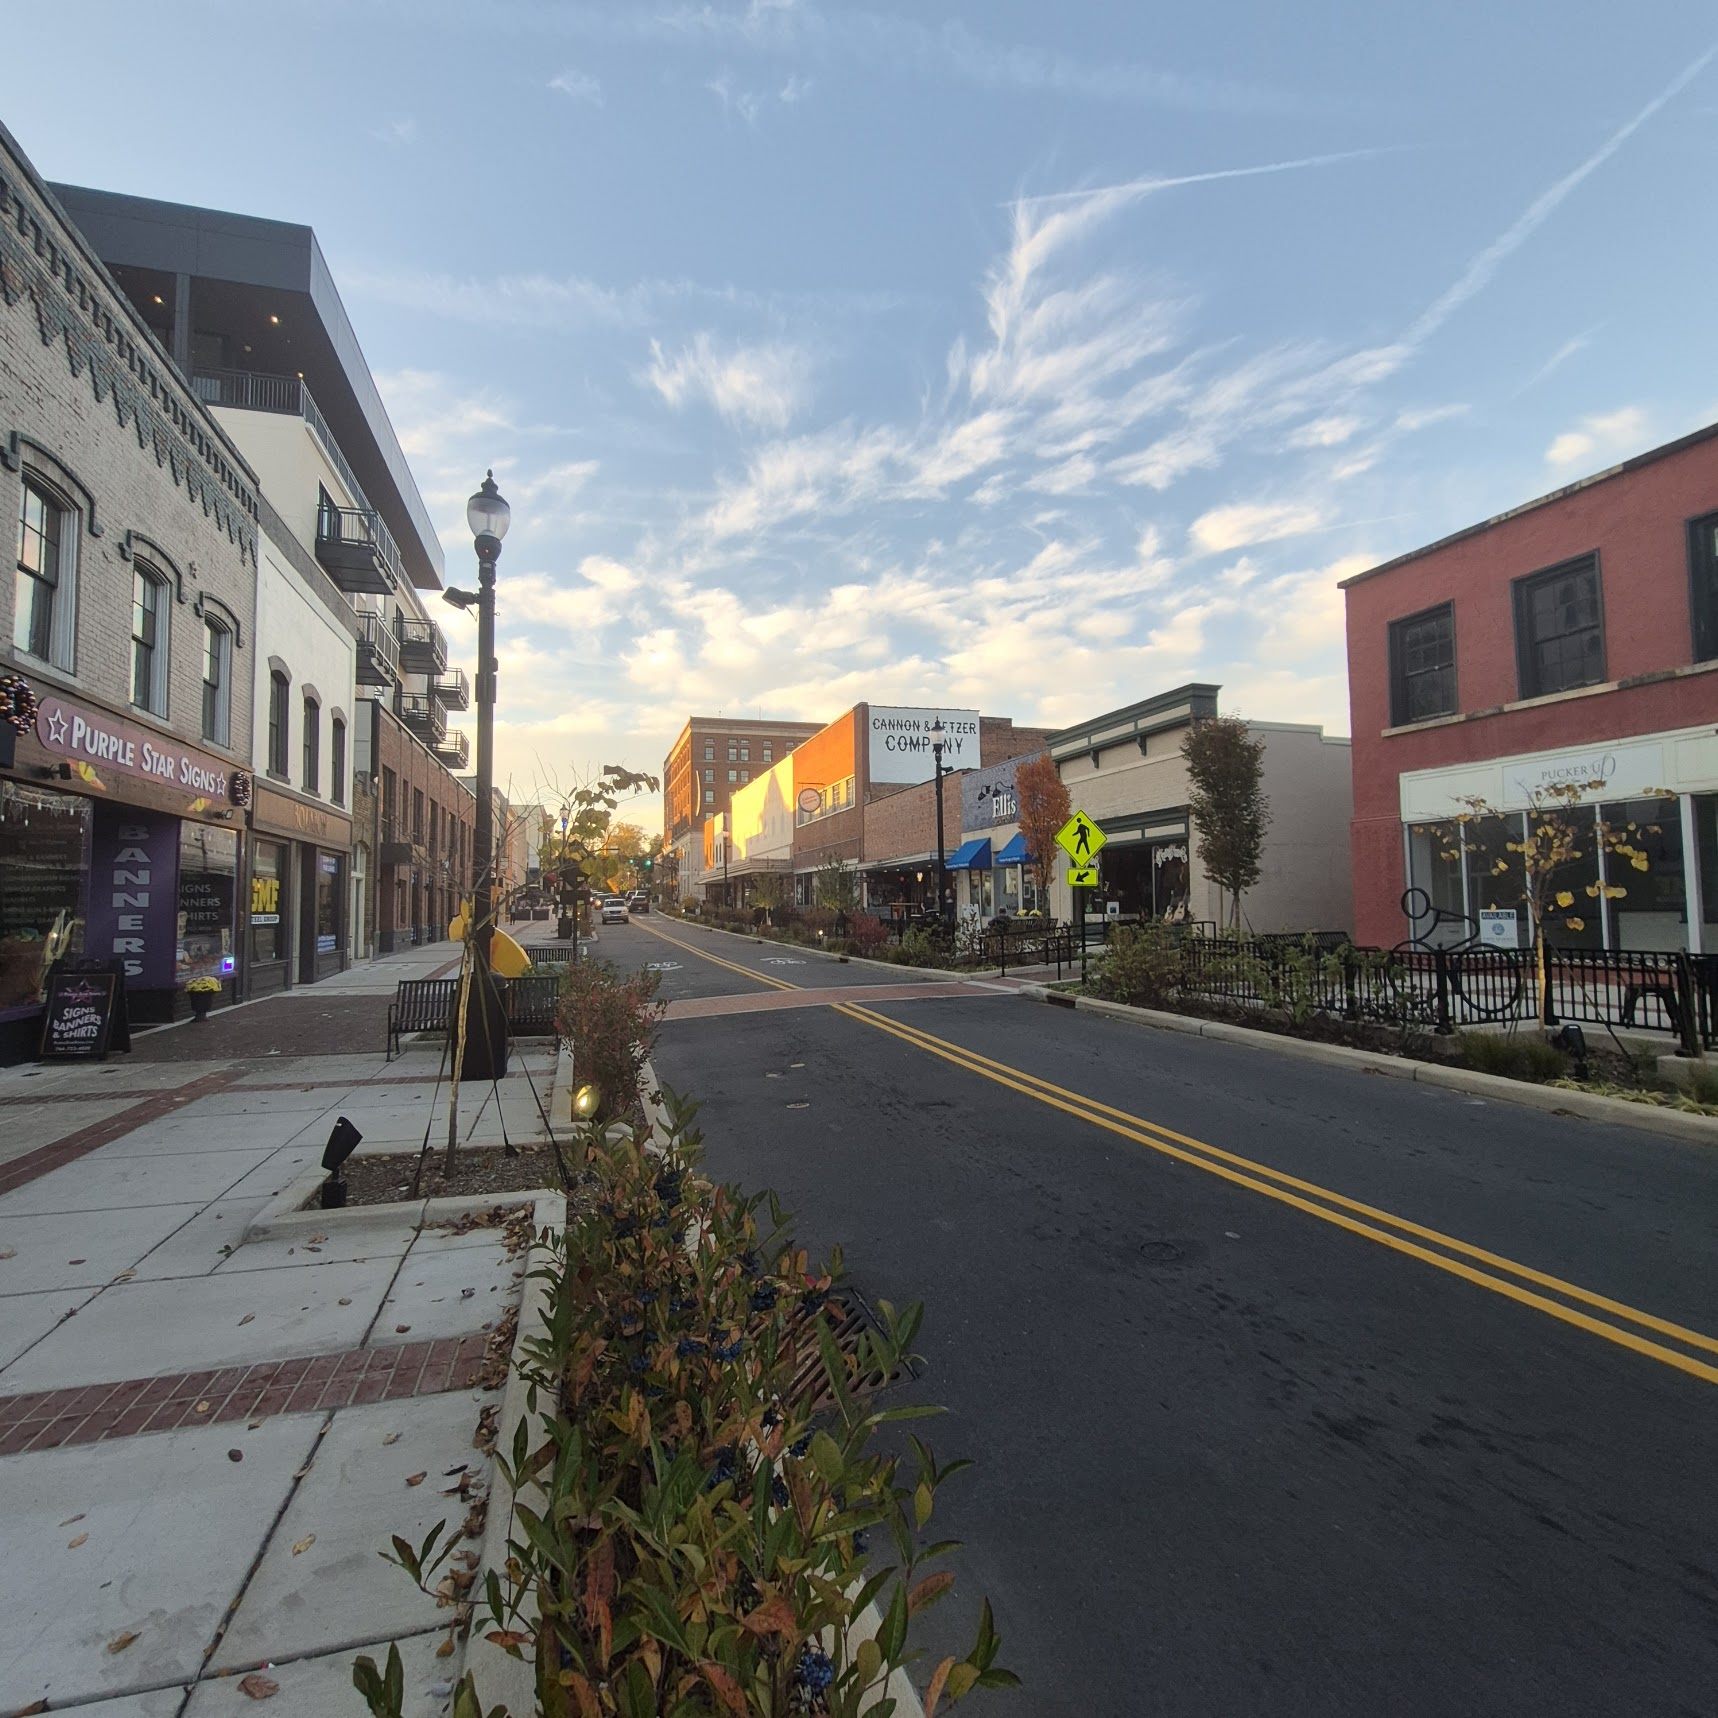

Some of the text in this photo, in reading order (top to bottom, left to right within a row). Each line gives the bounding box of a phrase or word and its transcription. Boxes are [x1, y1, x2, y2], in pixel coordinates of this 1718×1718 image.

[873, 718, 920, 731] CANNON
[924, 721, 931, 732] &
[885, 735, 964, 754] COMPNY
[1541, 765, 1588, 780] PUCKER
[992, 793, 1017, 818] Ellis
[180, 884, 211, 893] IGNS
[112, 824, 151, 976] BANNERS
[179, 898, 222, 907] NNERS
[187, 911, 219, 920] HIRTS
[63, 1006, 96, 1020] SIGNS
[53, 1013, 102, 1031] BANNERS
[63, 1025, 98, 1039] SHIRTS
